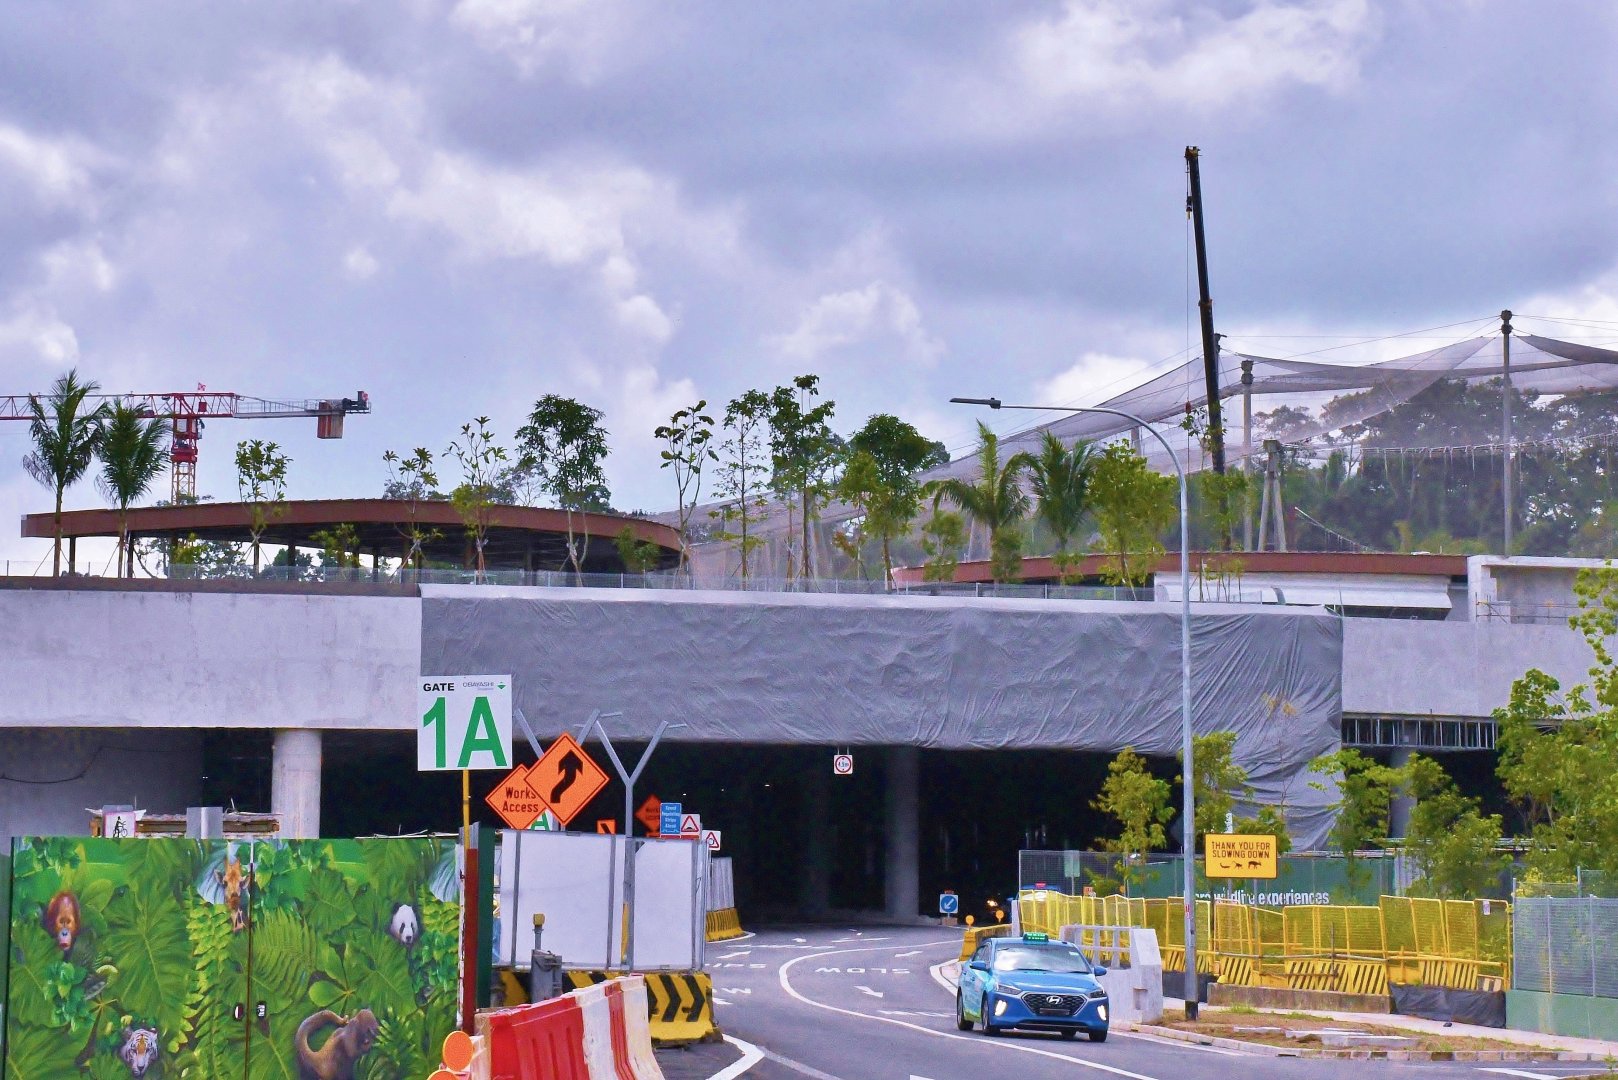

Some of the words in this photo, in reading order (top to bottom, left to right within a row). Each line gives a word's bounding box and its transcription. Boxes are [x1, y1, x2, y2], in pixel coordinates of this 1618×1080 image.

[423, 682, 455, 692] GATE
[423, 696, 507, 768] 1A
[505, 786, 537, 799] Works
[502, 801, 539, 813] Access
[1211, 841, 1236, 850] THANK
[1238, 841, 1254, 850] YOU
[1255, 842, 1271, 851] FOR
[1212, 850, 1246, 859] SLOWING
[1247, 850, 1270, 859] DOWN
[1258, 888, 1330, 906] experiences
